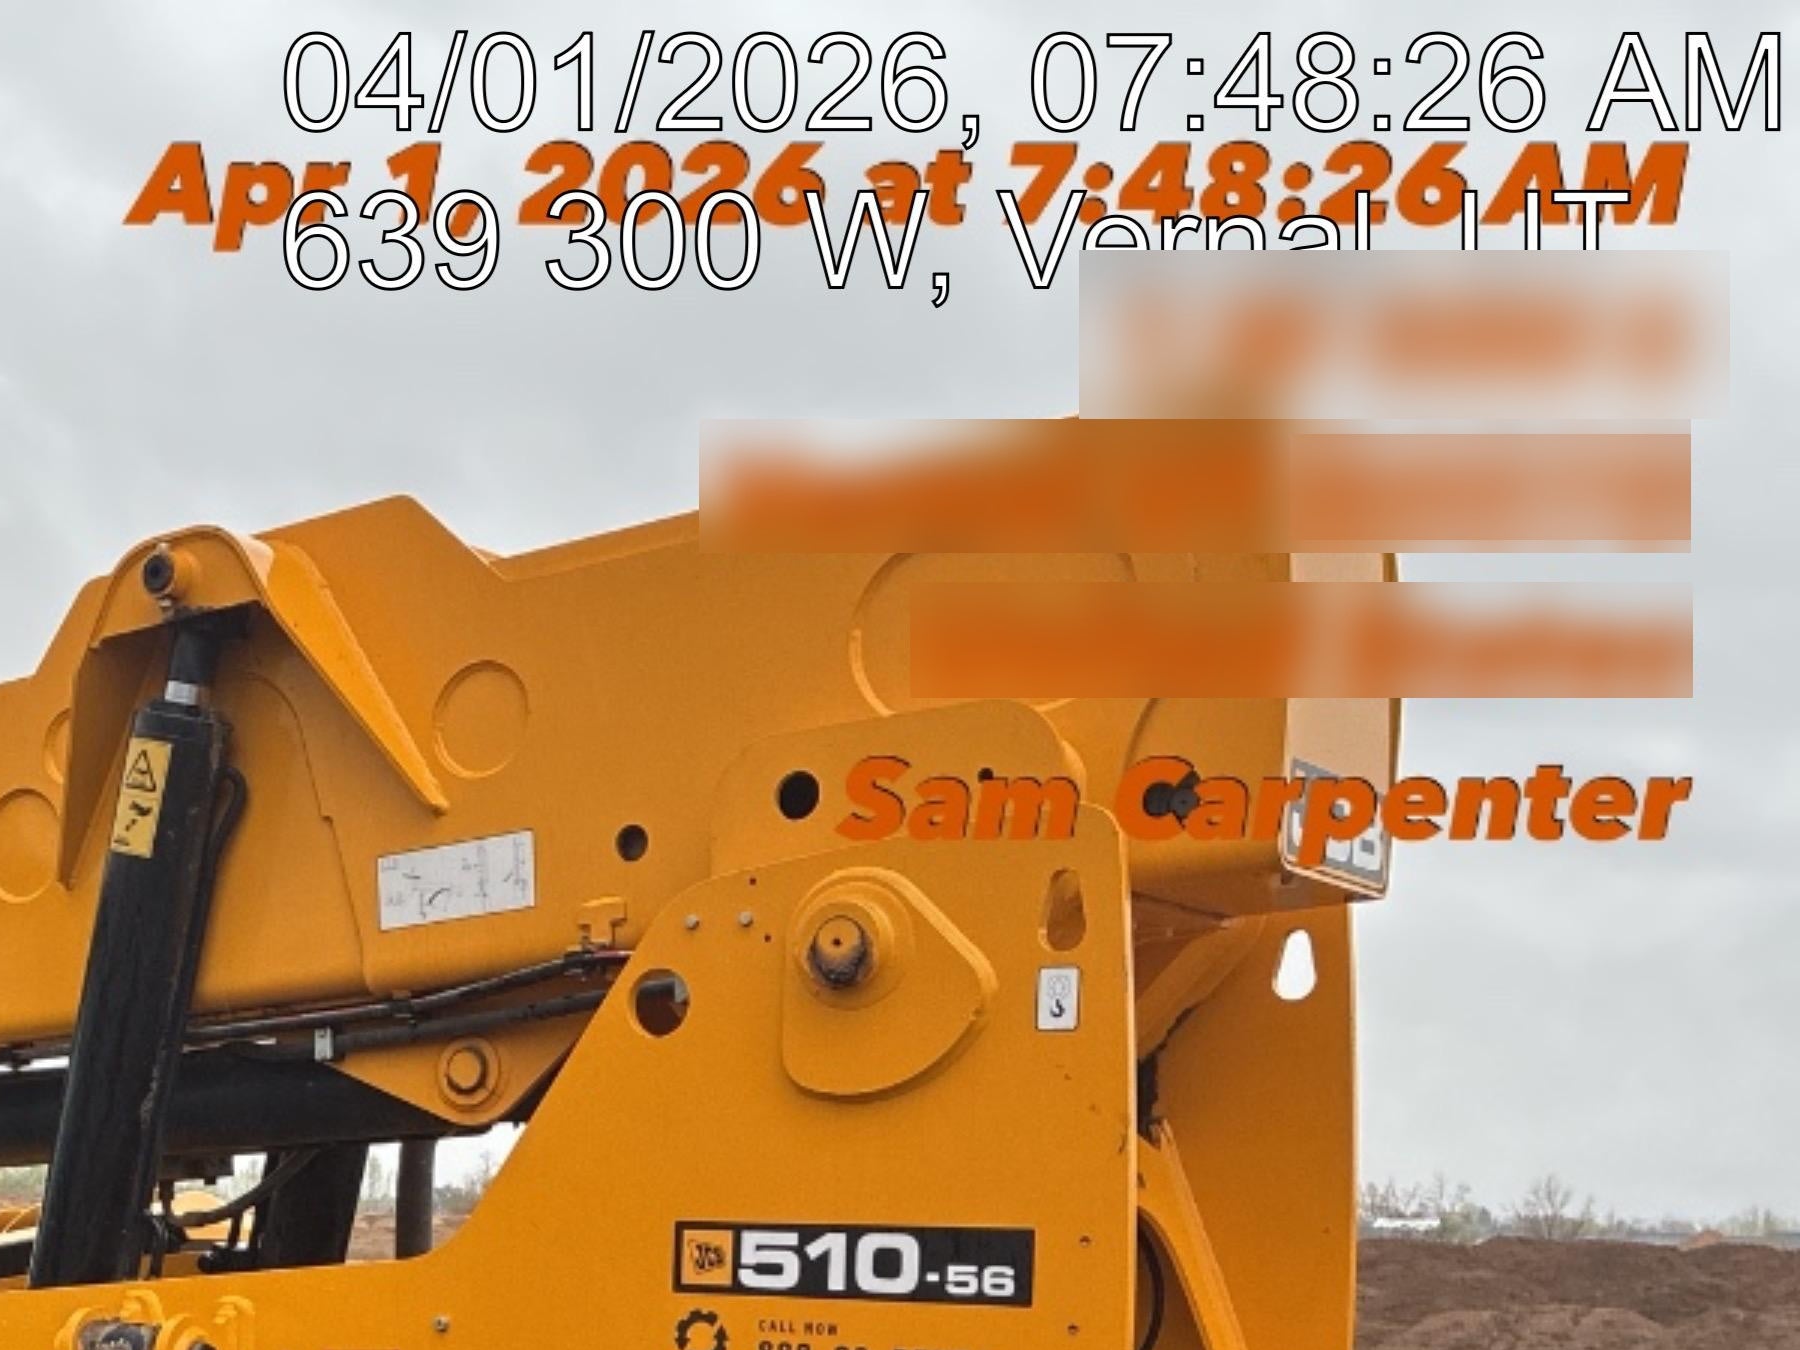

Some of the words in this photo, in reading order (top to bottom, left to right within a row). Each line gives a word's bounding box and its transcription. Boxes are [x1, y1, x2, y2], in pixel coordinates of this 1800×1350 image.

[737, 1230, 1016, 1297] 510-56
[758, 1320, 795, 1334] CALL
[804, 1322, 838, 1336] NOW
